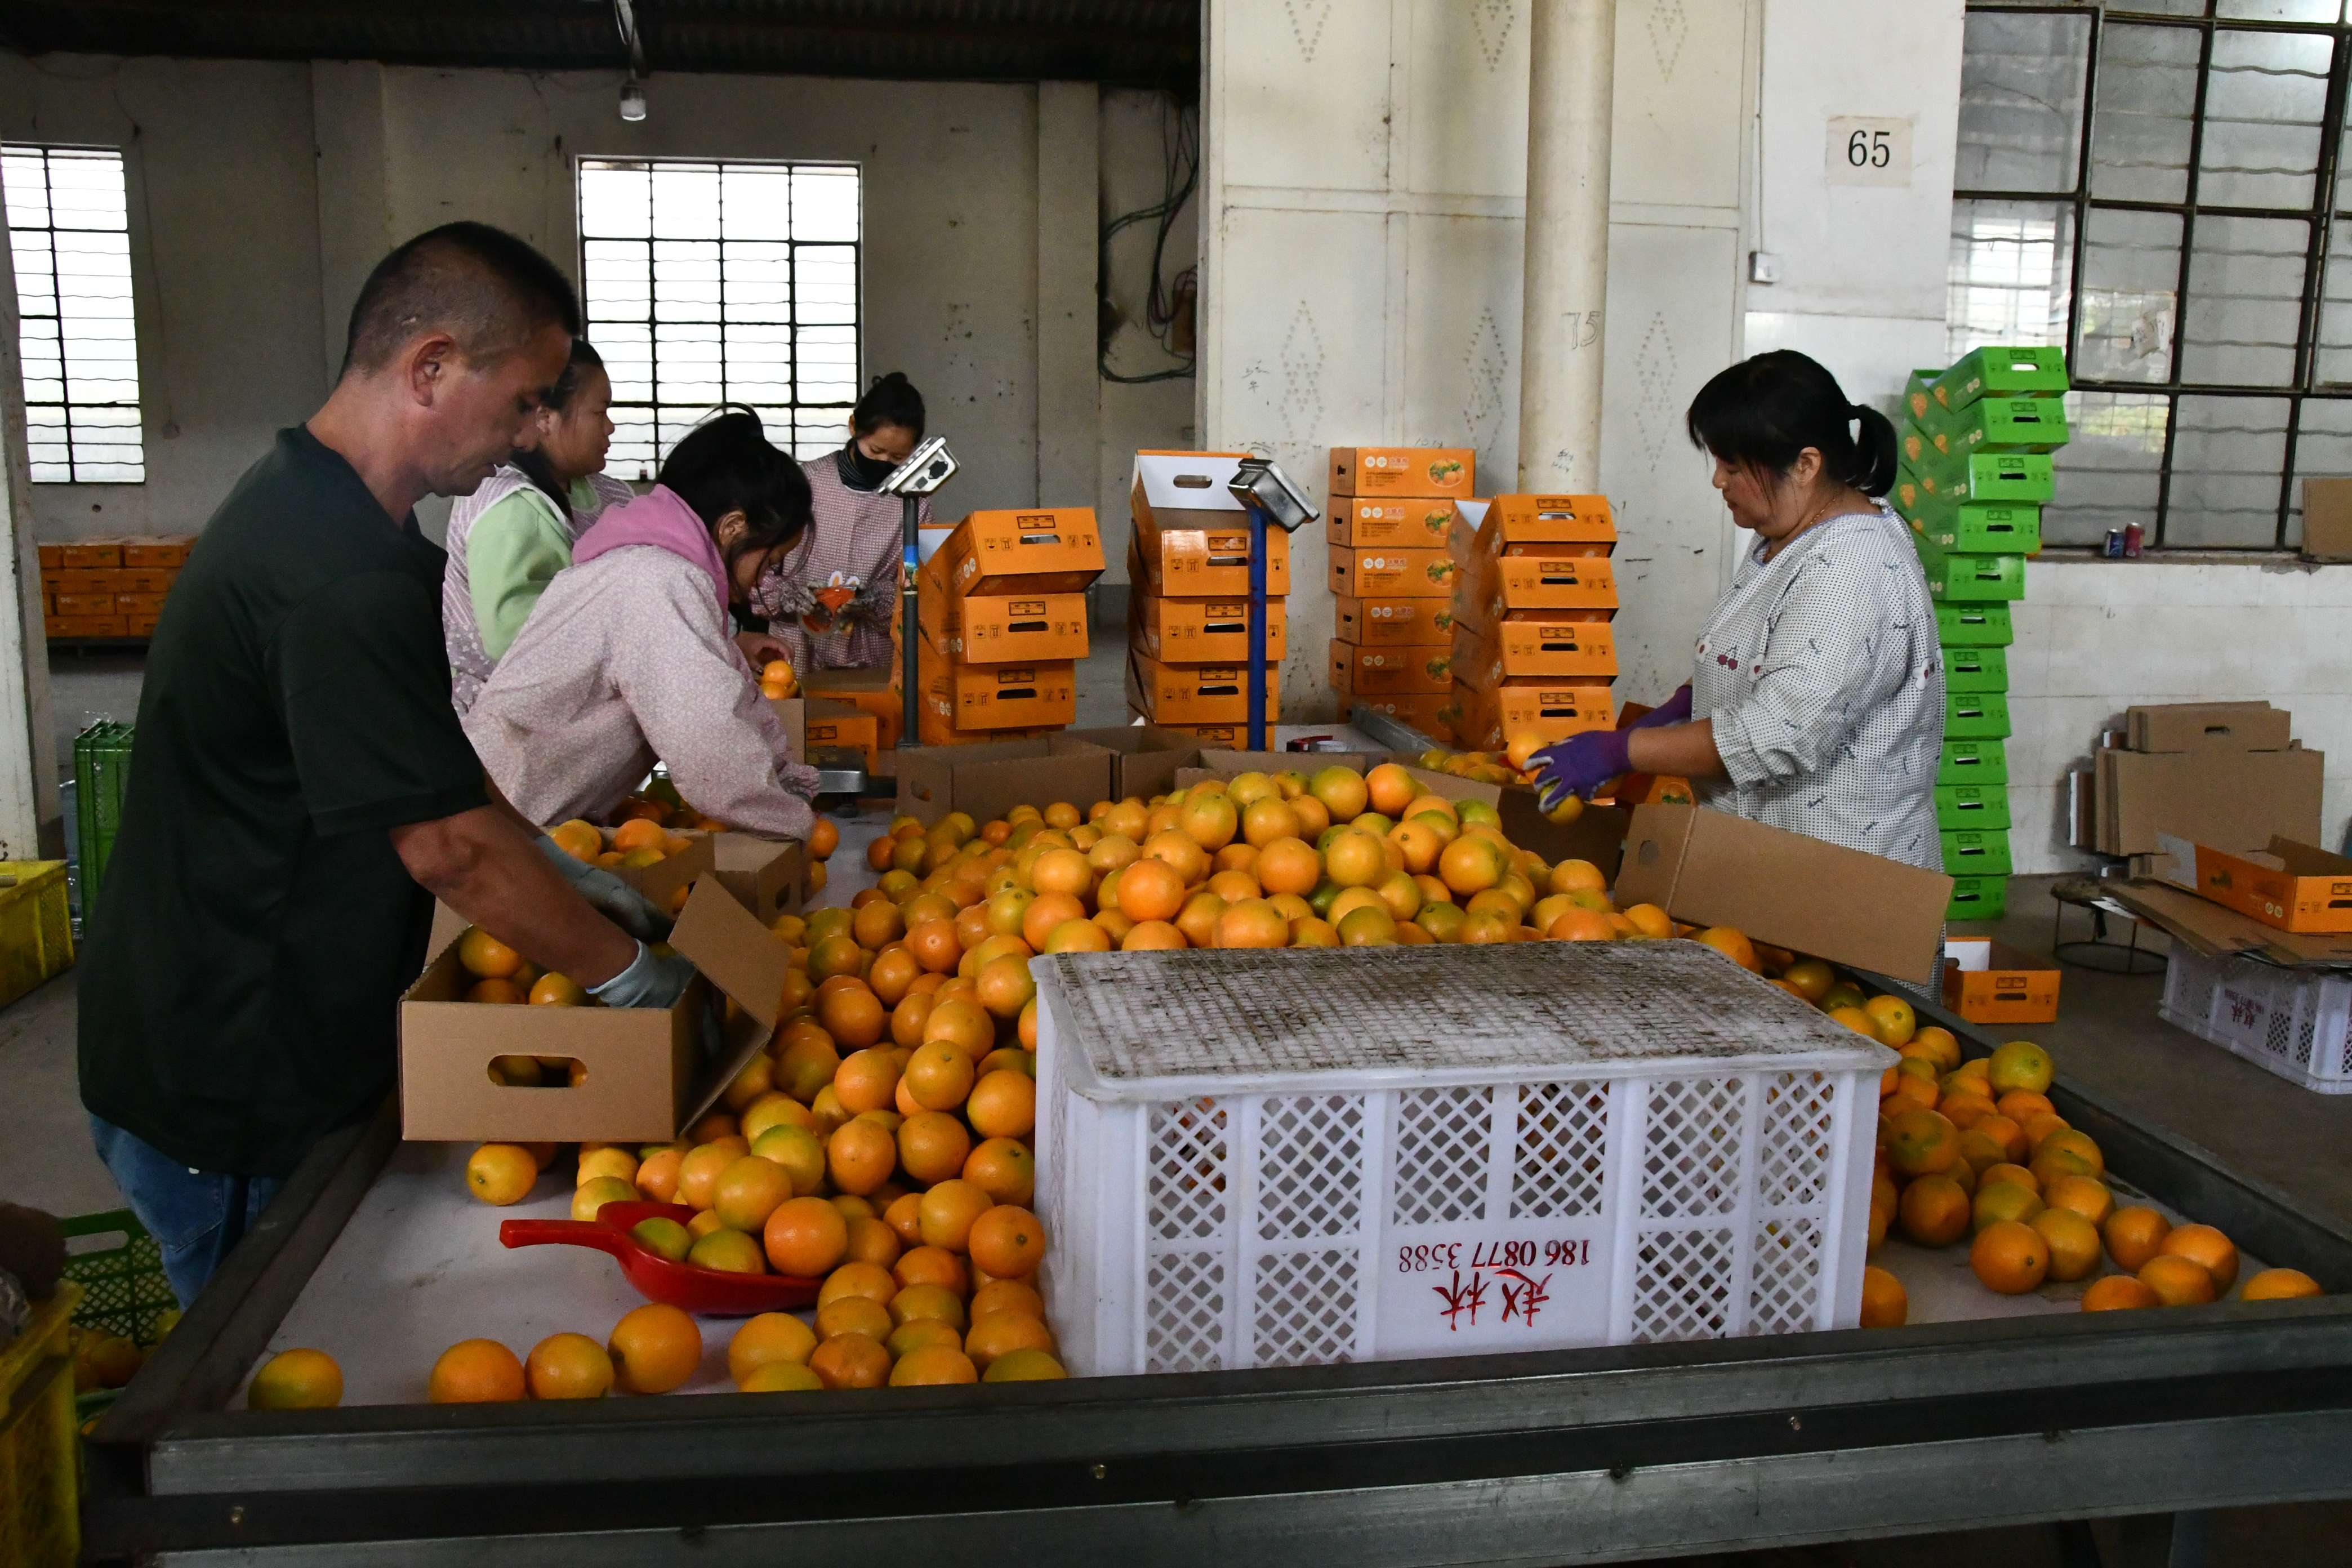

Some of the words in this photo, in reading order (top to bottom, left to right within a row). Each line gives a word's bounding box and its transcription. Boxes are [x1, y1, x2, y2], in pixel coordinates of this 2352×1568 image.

[1848, 128, 1891, 168] 65
[1561, 310, 1603, 350] 75
[1399, 1242, 1462, 1273] 3588
[1471, 1240, 1537, 1268] 0877
[1544, 1239, 1591, 1266] 186
[1432, 1268, 1553, 1331] 赵林
